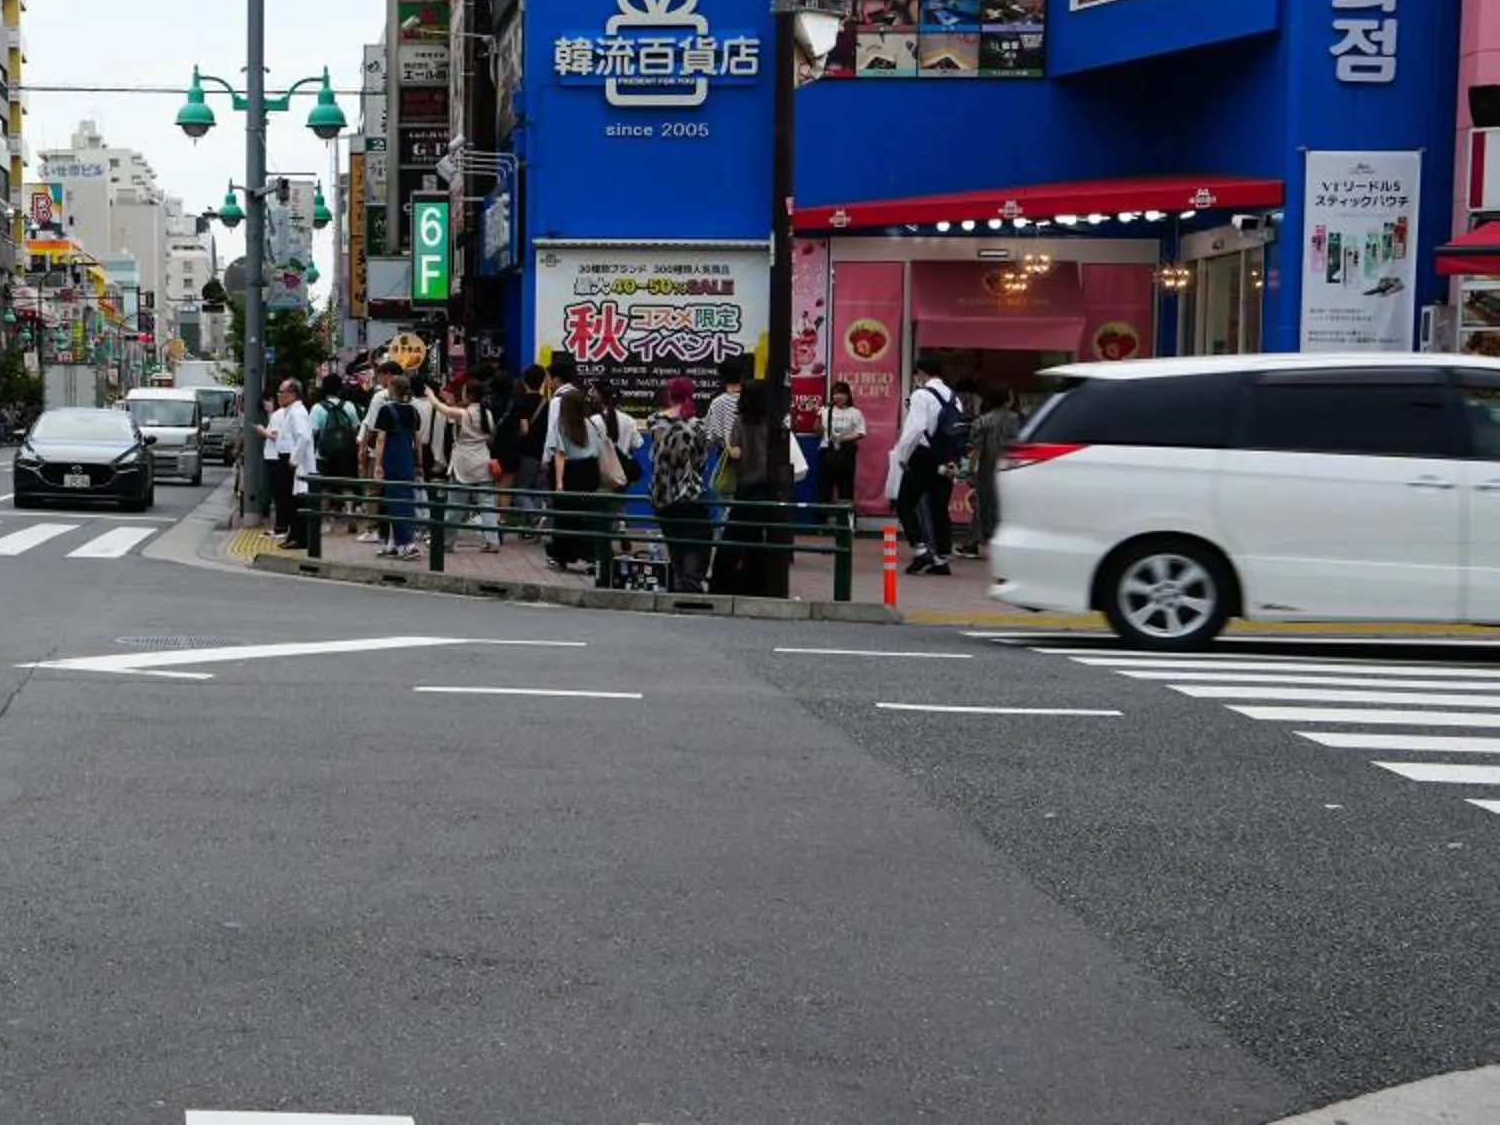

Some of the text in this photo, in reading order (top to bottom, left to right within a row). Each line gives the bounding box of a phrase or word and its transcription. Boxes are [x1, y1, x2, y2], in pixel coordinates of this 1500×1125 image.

[554, 35, 760, 77] 韓流百貨店
[606, 123, 709, 137] since 2005
[565, 302, 629, 363] 秋
[629, 304, 741, 333] コスメ限定
[630, 332, 743, 363] イベント
